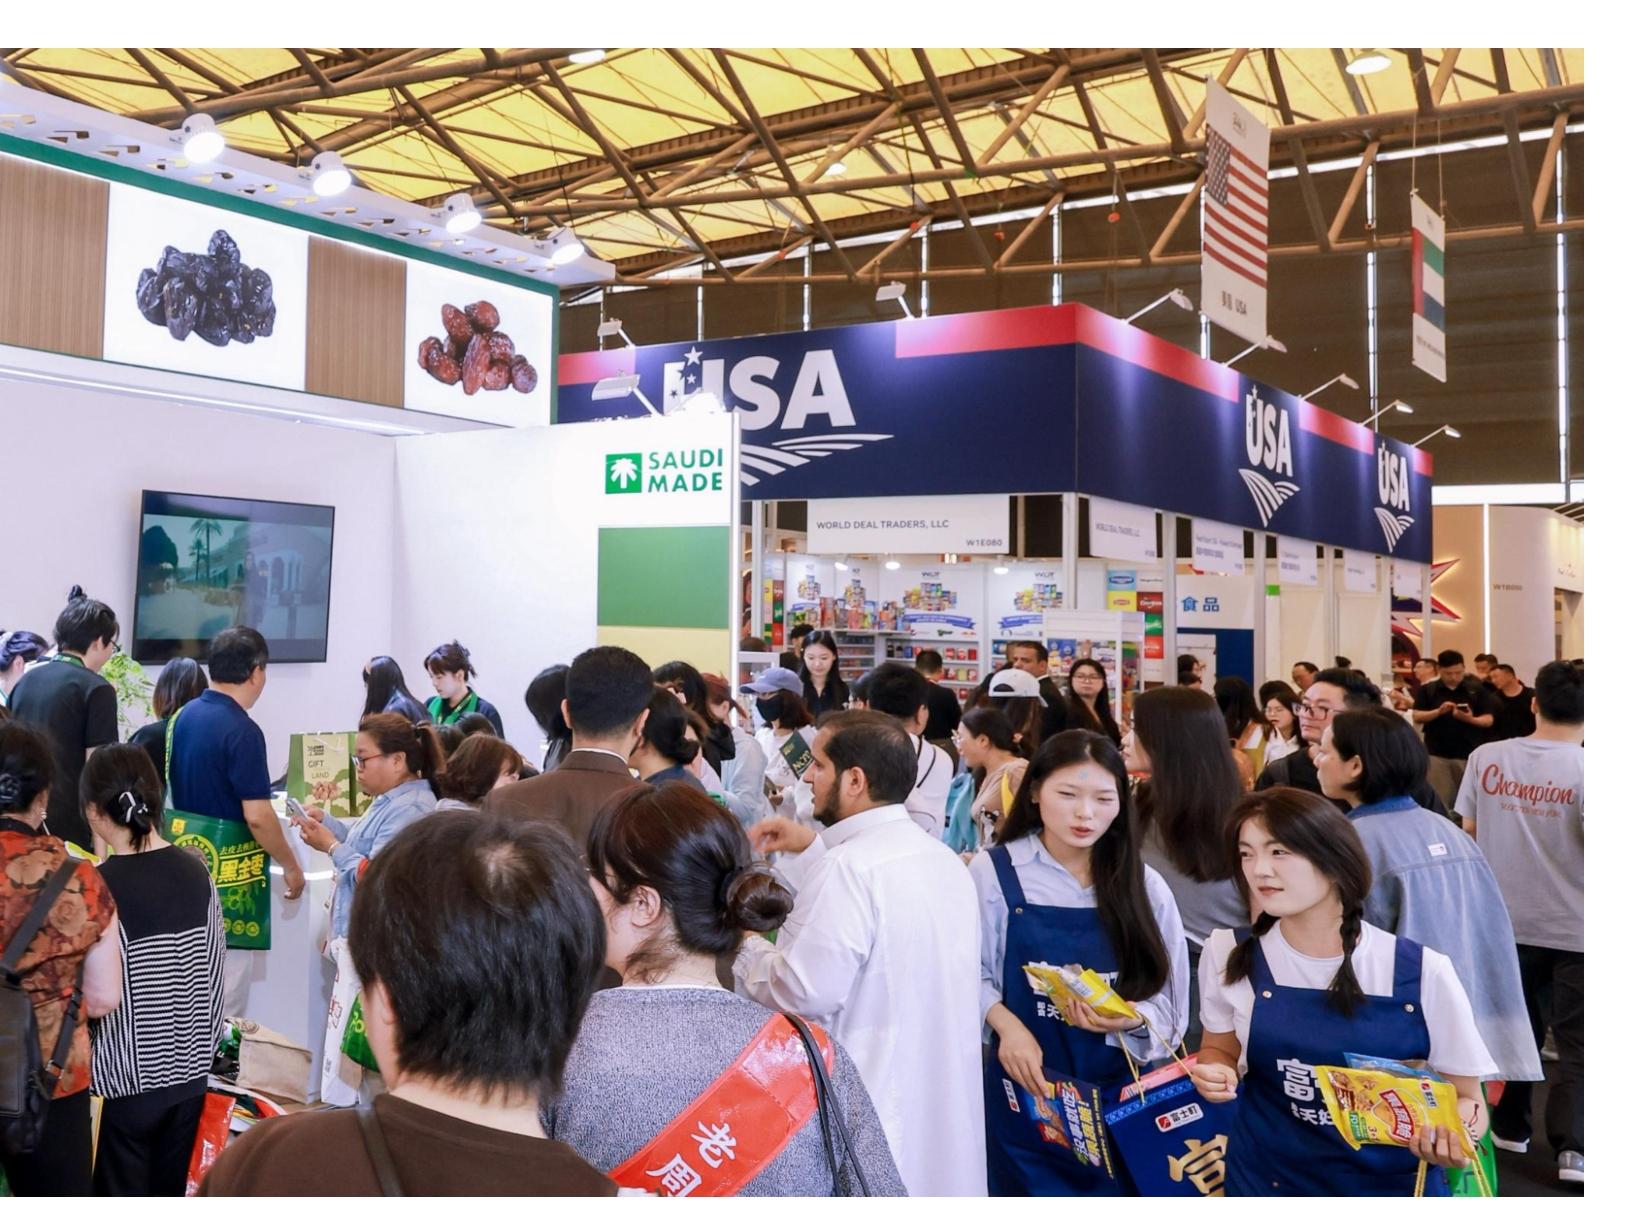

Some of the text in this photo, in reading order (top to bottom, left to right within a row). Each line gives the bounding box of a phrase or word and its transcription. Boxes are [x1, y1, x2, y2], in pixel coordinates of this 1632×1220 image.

[663, 349, 856, 431] USA
[1245, 392, 1294, 477] USA
[648, 448, 724, 470] SAUDI
[648, 471, 723, 493] MADE
[1377, 448, 1411, 513] USA
[817, 520, 949, 529] WORLD DEAL TRADERS, LLC
[1180, 596, 1220, 612] 食品
[308, 760, 324, 768] GIFT
[311, 771, 329, 779] LAND
[1481, 763, 1576, 807] Champion
